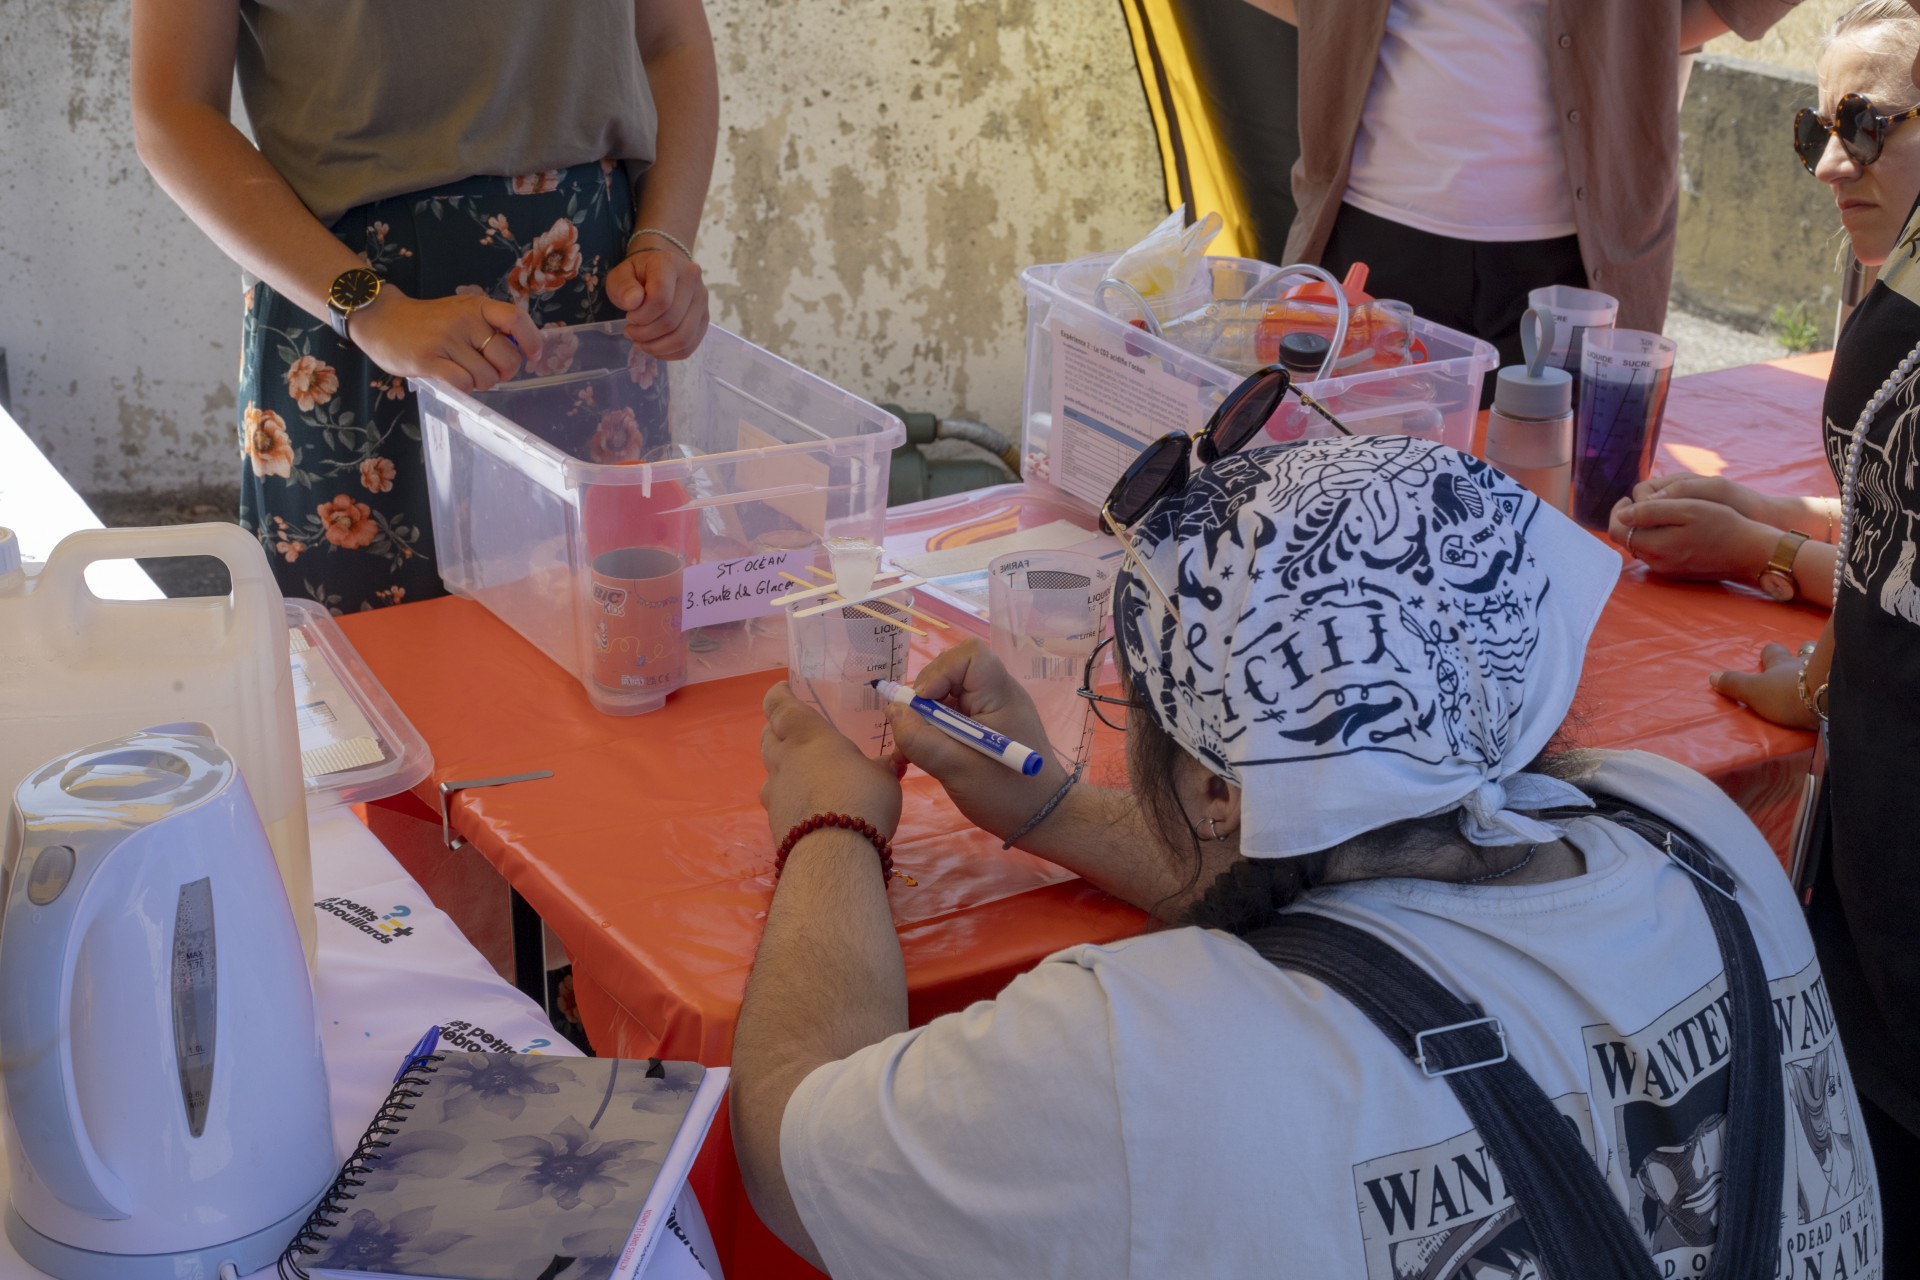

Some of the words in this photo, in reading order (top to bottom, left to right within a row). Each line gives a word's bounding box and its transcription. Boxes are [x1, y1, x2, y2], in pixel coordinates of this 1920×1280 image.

[1587, 350, 1613, 363] LIQUIDE
[1623, 360, 1651, 368] SUCRE
[593, 585, 624, 604] BIC
[866, 663, 887, 672] LITRE
[334, 899, 379, 922] petits
[186, 951, 203, 960] MAX
[1797, 1222, 1832, 1253] DEAD
[1840, 1210, 1852, 1234] OR
